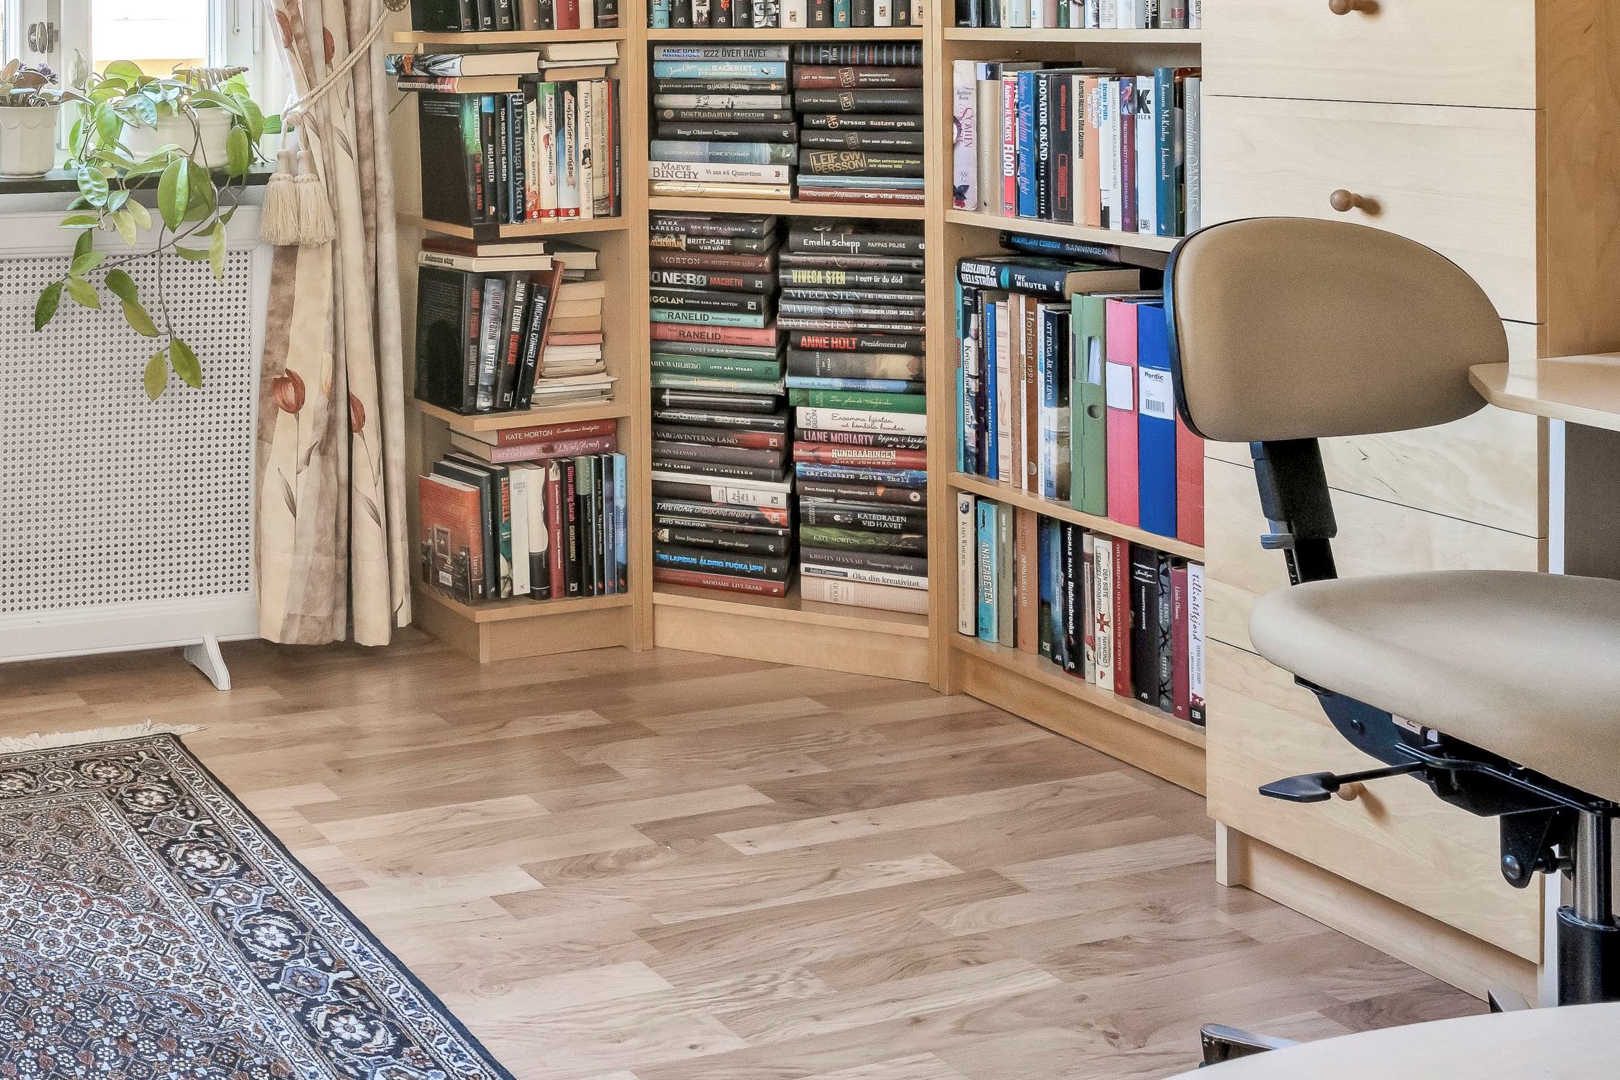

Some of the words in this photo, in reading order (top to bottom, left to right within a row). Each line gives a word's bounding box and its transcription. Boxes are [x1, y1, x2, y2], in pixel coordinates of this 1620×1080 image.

[722, 47, 740, 57] ÖVER
[743, 49, 767, 57] HAVET
[1039, 80, 1047, 126] DONATOR
[513, 108, 521, 134] Den
[513, 138, 523, 169] långa
[811, 153, 837, 164] LEIF
[839, 151, 860, 163] GW
[661, 163, 691, 171] MAEVE
[814, 160, 863, 173] PERSSON
[653, 168, 699, 179] BINCHY
[514, 171, 524, 214] flykten
[803, 233, 830, 246] Emelie
[832, 234, 860, 253] Schepp
[1066, 244, 1108, 255] SANNINGEN
[709, 278, 743, 287] MACBETH
[792, 270, 822, 284] VIVECA
[825, 272, 845, 284] STEN
[1017, 280, 1047, 290] MINUTER
[668, 312, 709, 321] RANELID
[679, 330, 722, 339] RANELID
[801, 336, 829, 348] ANNE
[831, 337, 857, 349] HOLT
[1145, 372, 1164, 381] Nordic
[506, 432, 522, 440] KATE
[525, 430, 553, 438] MORTON
[803, 431, 828, 441] LIANE
[831, 433, 873, 445] MORIARTY
[831, 448, 896, 460] HUNDRAÅRINGEN
[857, 513, 907, 523] KATEDRALEN
[981, 541, 994, 604] ANALFABETEN
